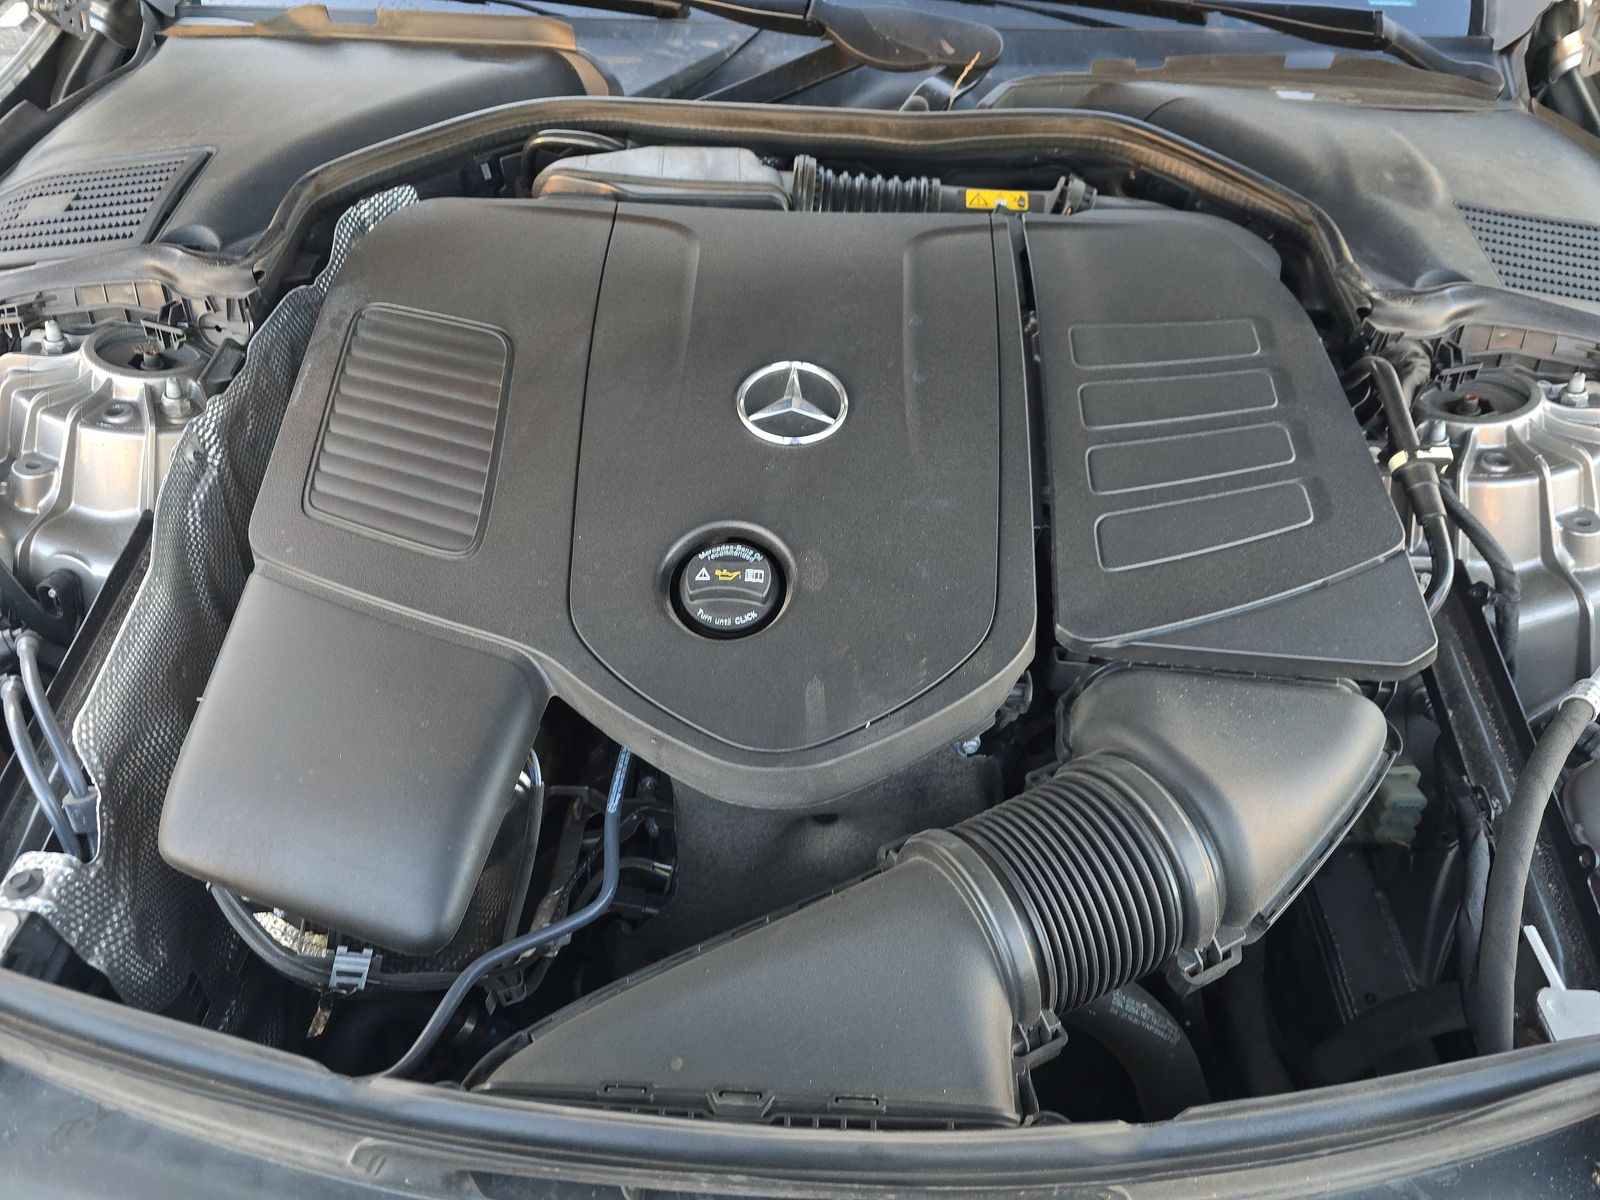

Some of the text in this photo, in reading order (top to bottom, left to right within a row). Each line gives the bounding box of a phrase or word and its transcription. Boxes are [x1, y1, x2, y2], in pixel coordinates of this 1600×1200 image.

[697, 608, 758, 627] Turn until CLICK
